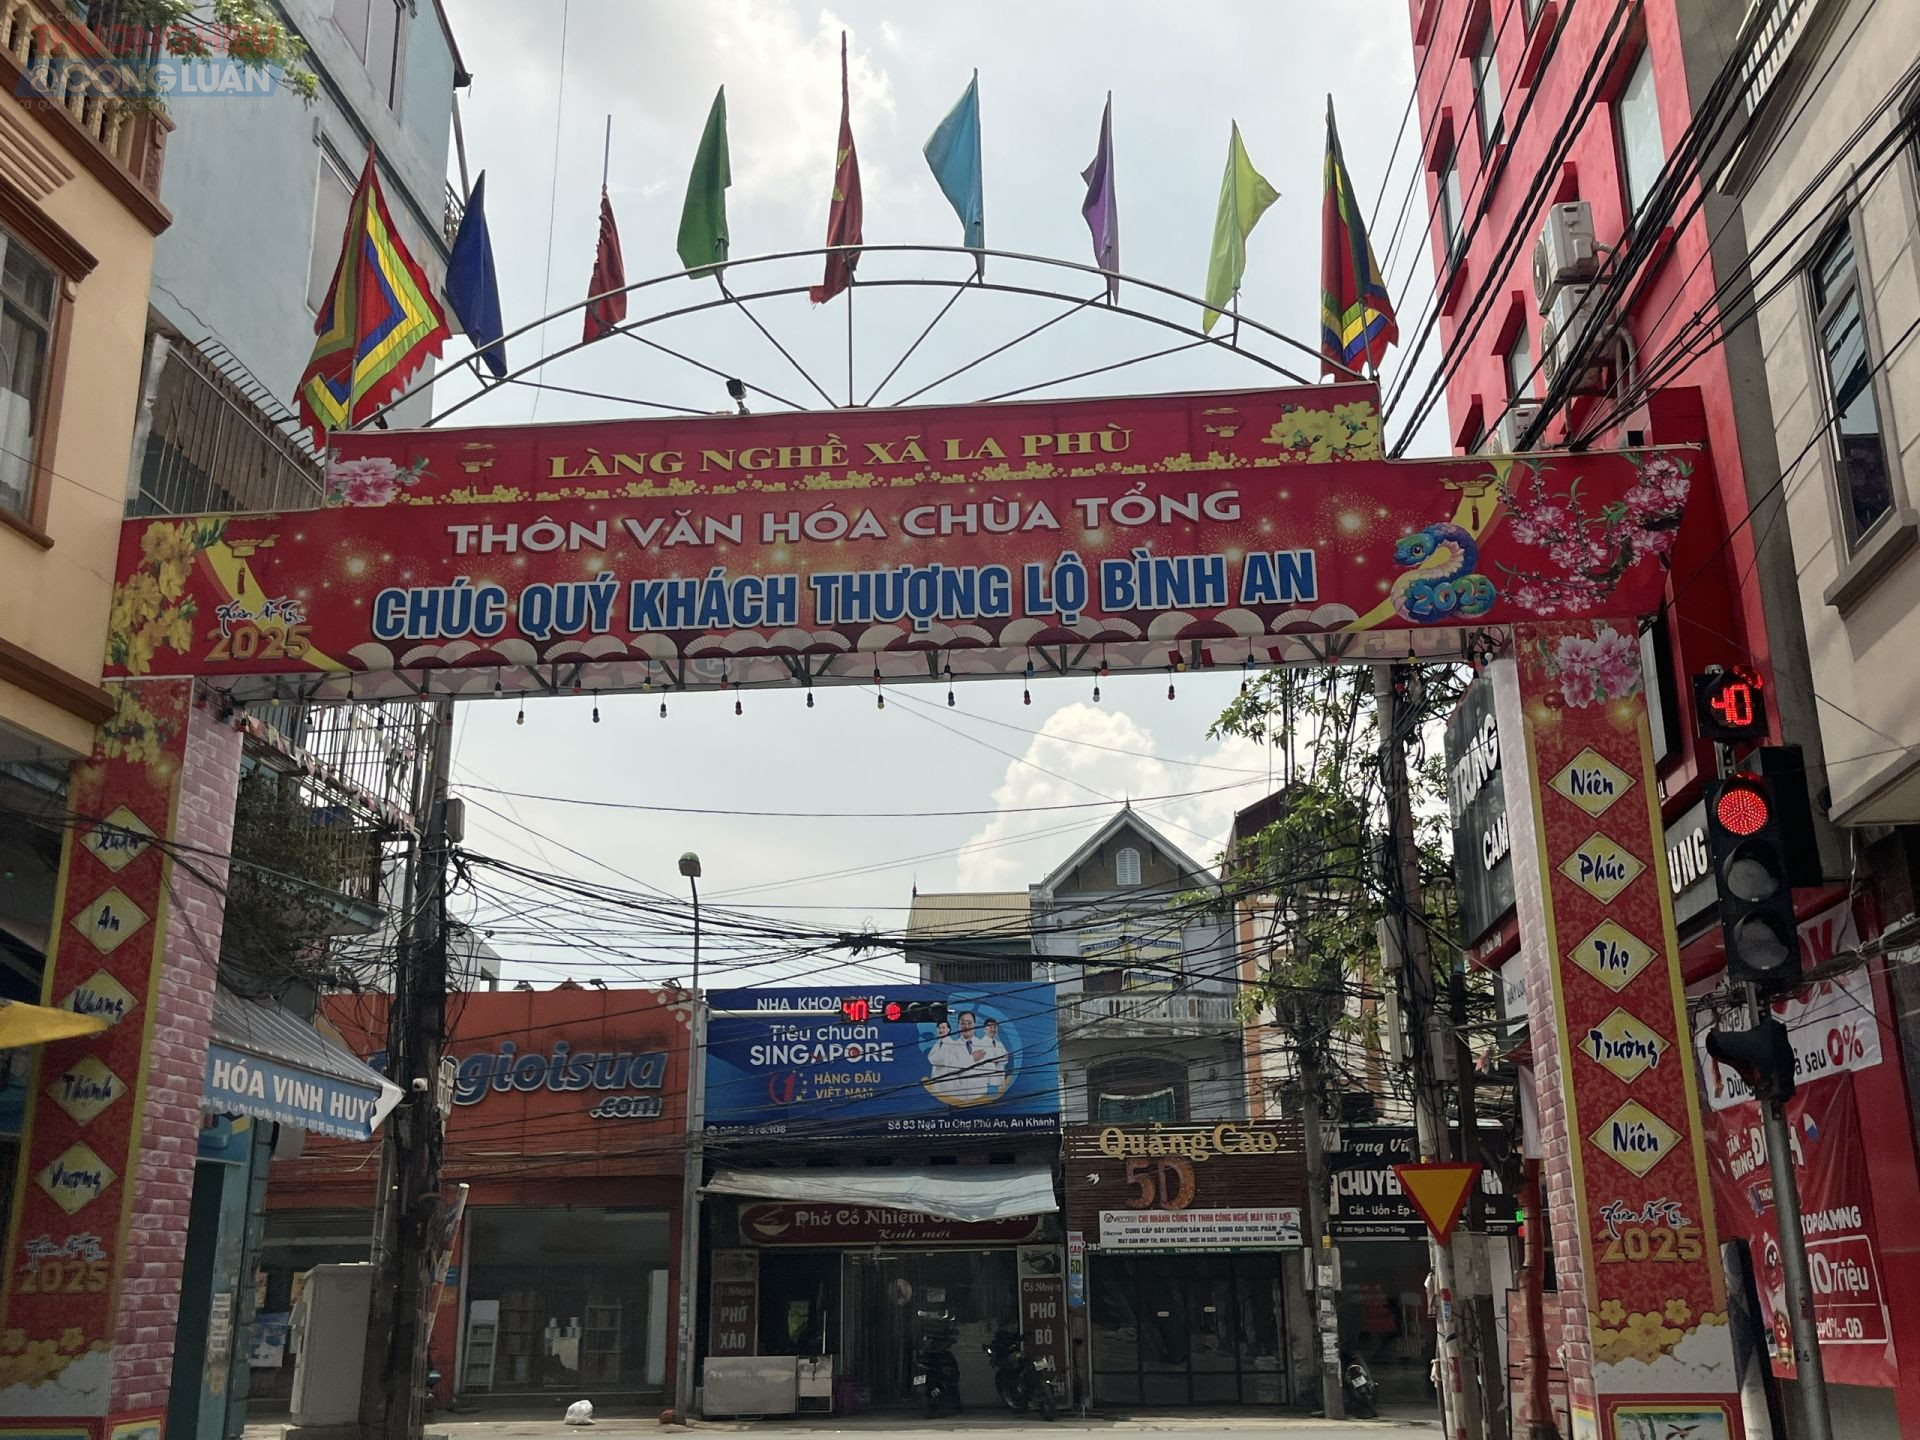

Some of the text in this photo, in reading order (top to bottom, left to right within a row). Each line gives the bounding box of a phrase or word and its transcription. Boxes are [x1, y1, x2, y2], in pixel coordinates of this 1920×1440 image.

[549, 423, 1133, 480] LÀNG NGHỀ XÃ LA PHÙ
[447, 481, 1241, 555] THÔN VĂN HÓA CHÙA TỔNG
[371, 547, 1319, 642] CHÚC QUÝ KHÁCH THƯỢNG LỘ BÌNH AN
[203, 625, 313, 661] 2025
[1711, 684, 1752, 726] 40
[1451, 713, 1498, 820] TRUNG
[1571, 767, 1614, 796] Niên
[1577, 852, 1626, 883] Phúc
[1667, 826, 1708, 894] UNG
[98, 905, 120, 932] An
[1594, 939, 1629, 976] Thọ
[798, 996, 842, 1010] KHOA
[770, 1025, 811, 1042] Tiêu
[1588, 1029, 1659, 1068] Trường
[1805, 1050, 1827, 1072] sau
[1827, 1023, 1865, 1066] 0%
[750, 1042, 894, 1066] SINGAPORE
[212, 1058, 265, 1099] HÓA
[273, 1075, 324, 1114] VINH
[814, 1071, 851, 1084] HÀNG
[590, 1096, 663, 1119] .com
[1099, 1119, 1278, 1161] Quảng Cáo
[1612, 1122, 1659, 1153] Niên
[1126, 1156, 1197, 1210] 5D
[795, 1209, 832, 1226] Phở
[1598, 1227, 1702, 1263] 2025
[18, 1260, 109, 1294] 2025
[1831, 1258, 1870, 1297] Triệu
[1029, 1296, 1057, 1319] PHỞ
